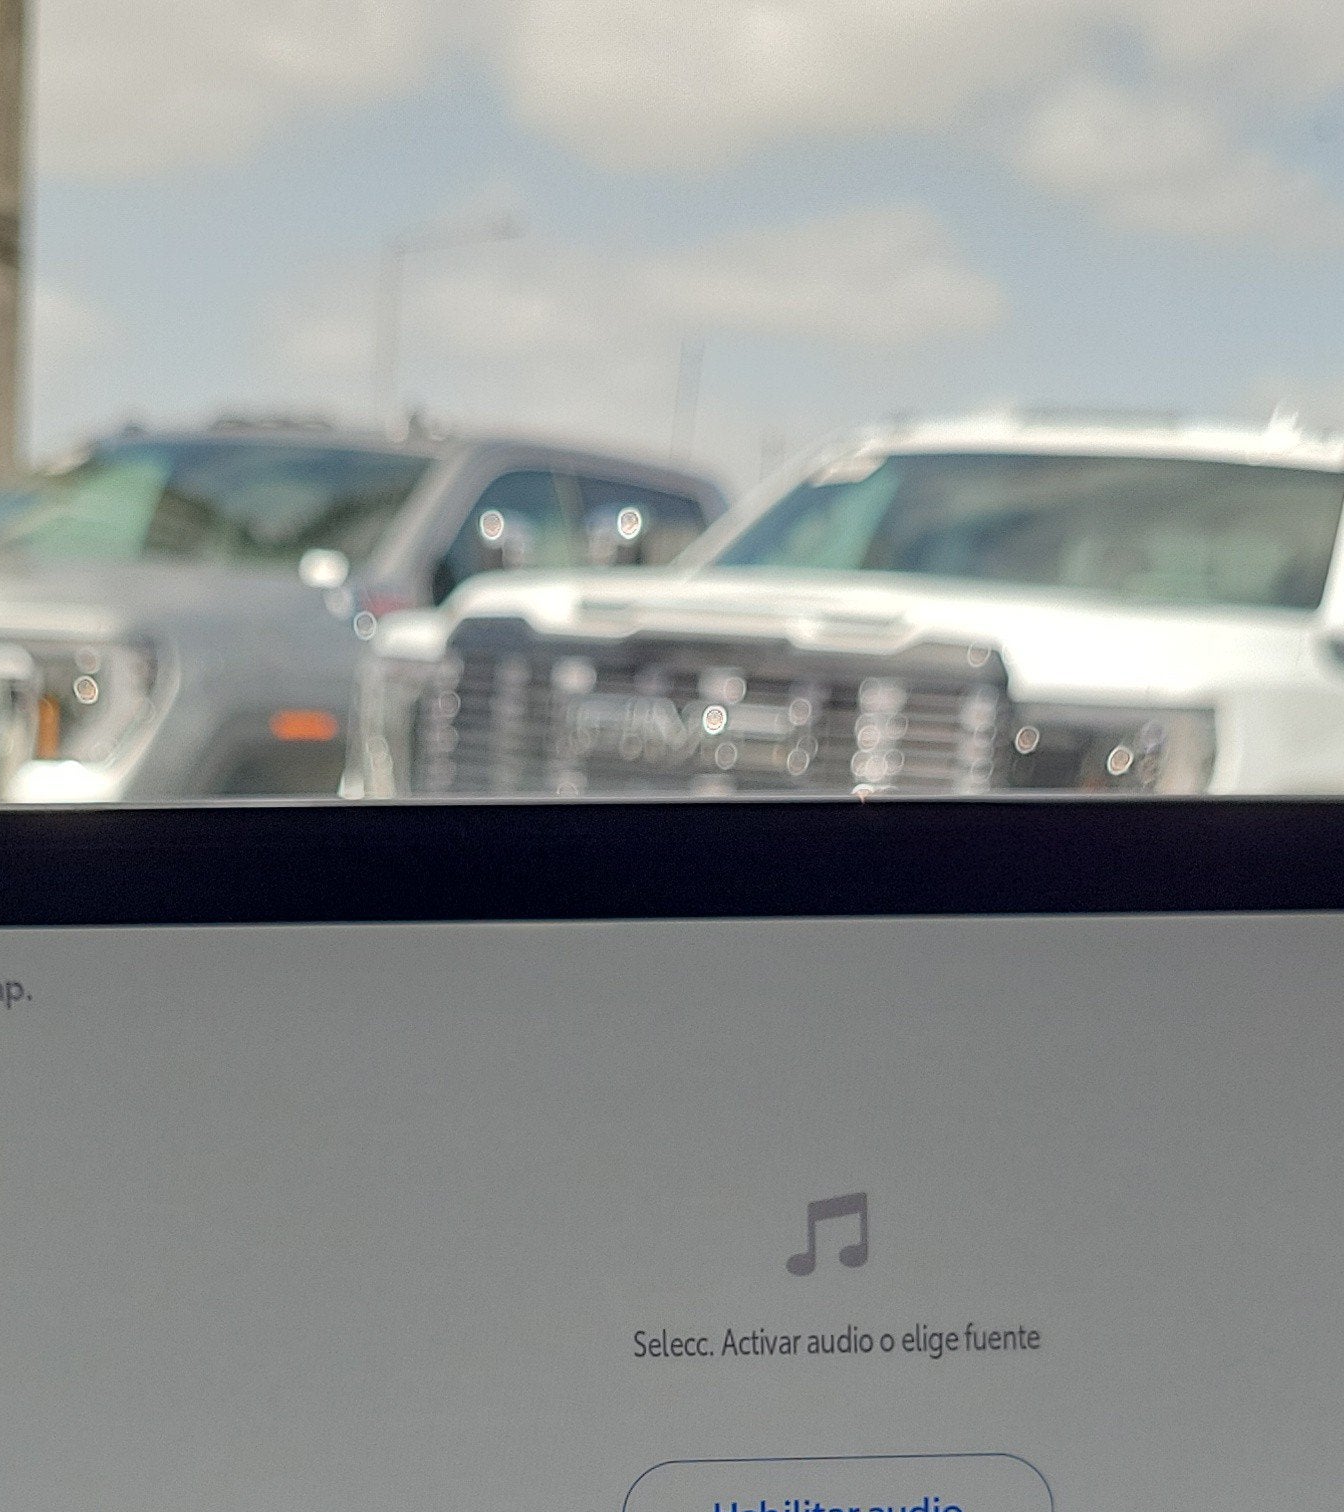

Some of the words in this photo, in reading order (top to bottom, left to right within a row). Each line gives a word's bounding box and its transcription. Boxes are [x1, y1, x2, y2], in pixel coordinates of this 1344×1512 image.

[633, 1329, 715, 1359] Selecc.
[722, 1326, 802, 1357] Activar
[807, 1324, 874, 1355] audio
[880, 1332, 895, 1353] o
[901, 1323, 959, 1360] elige
[963, 1322, 1041, 1352] fuente
